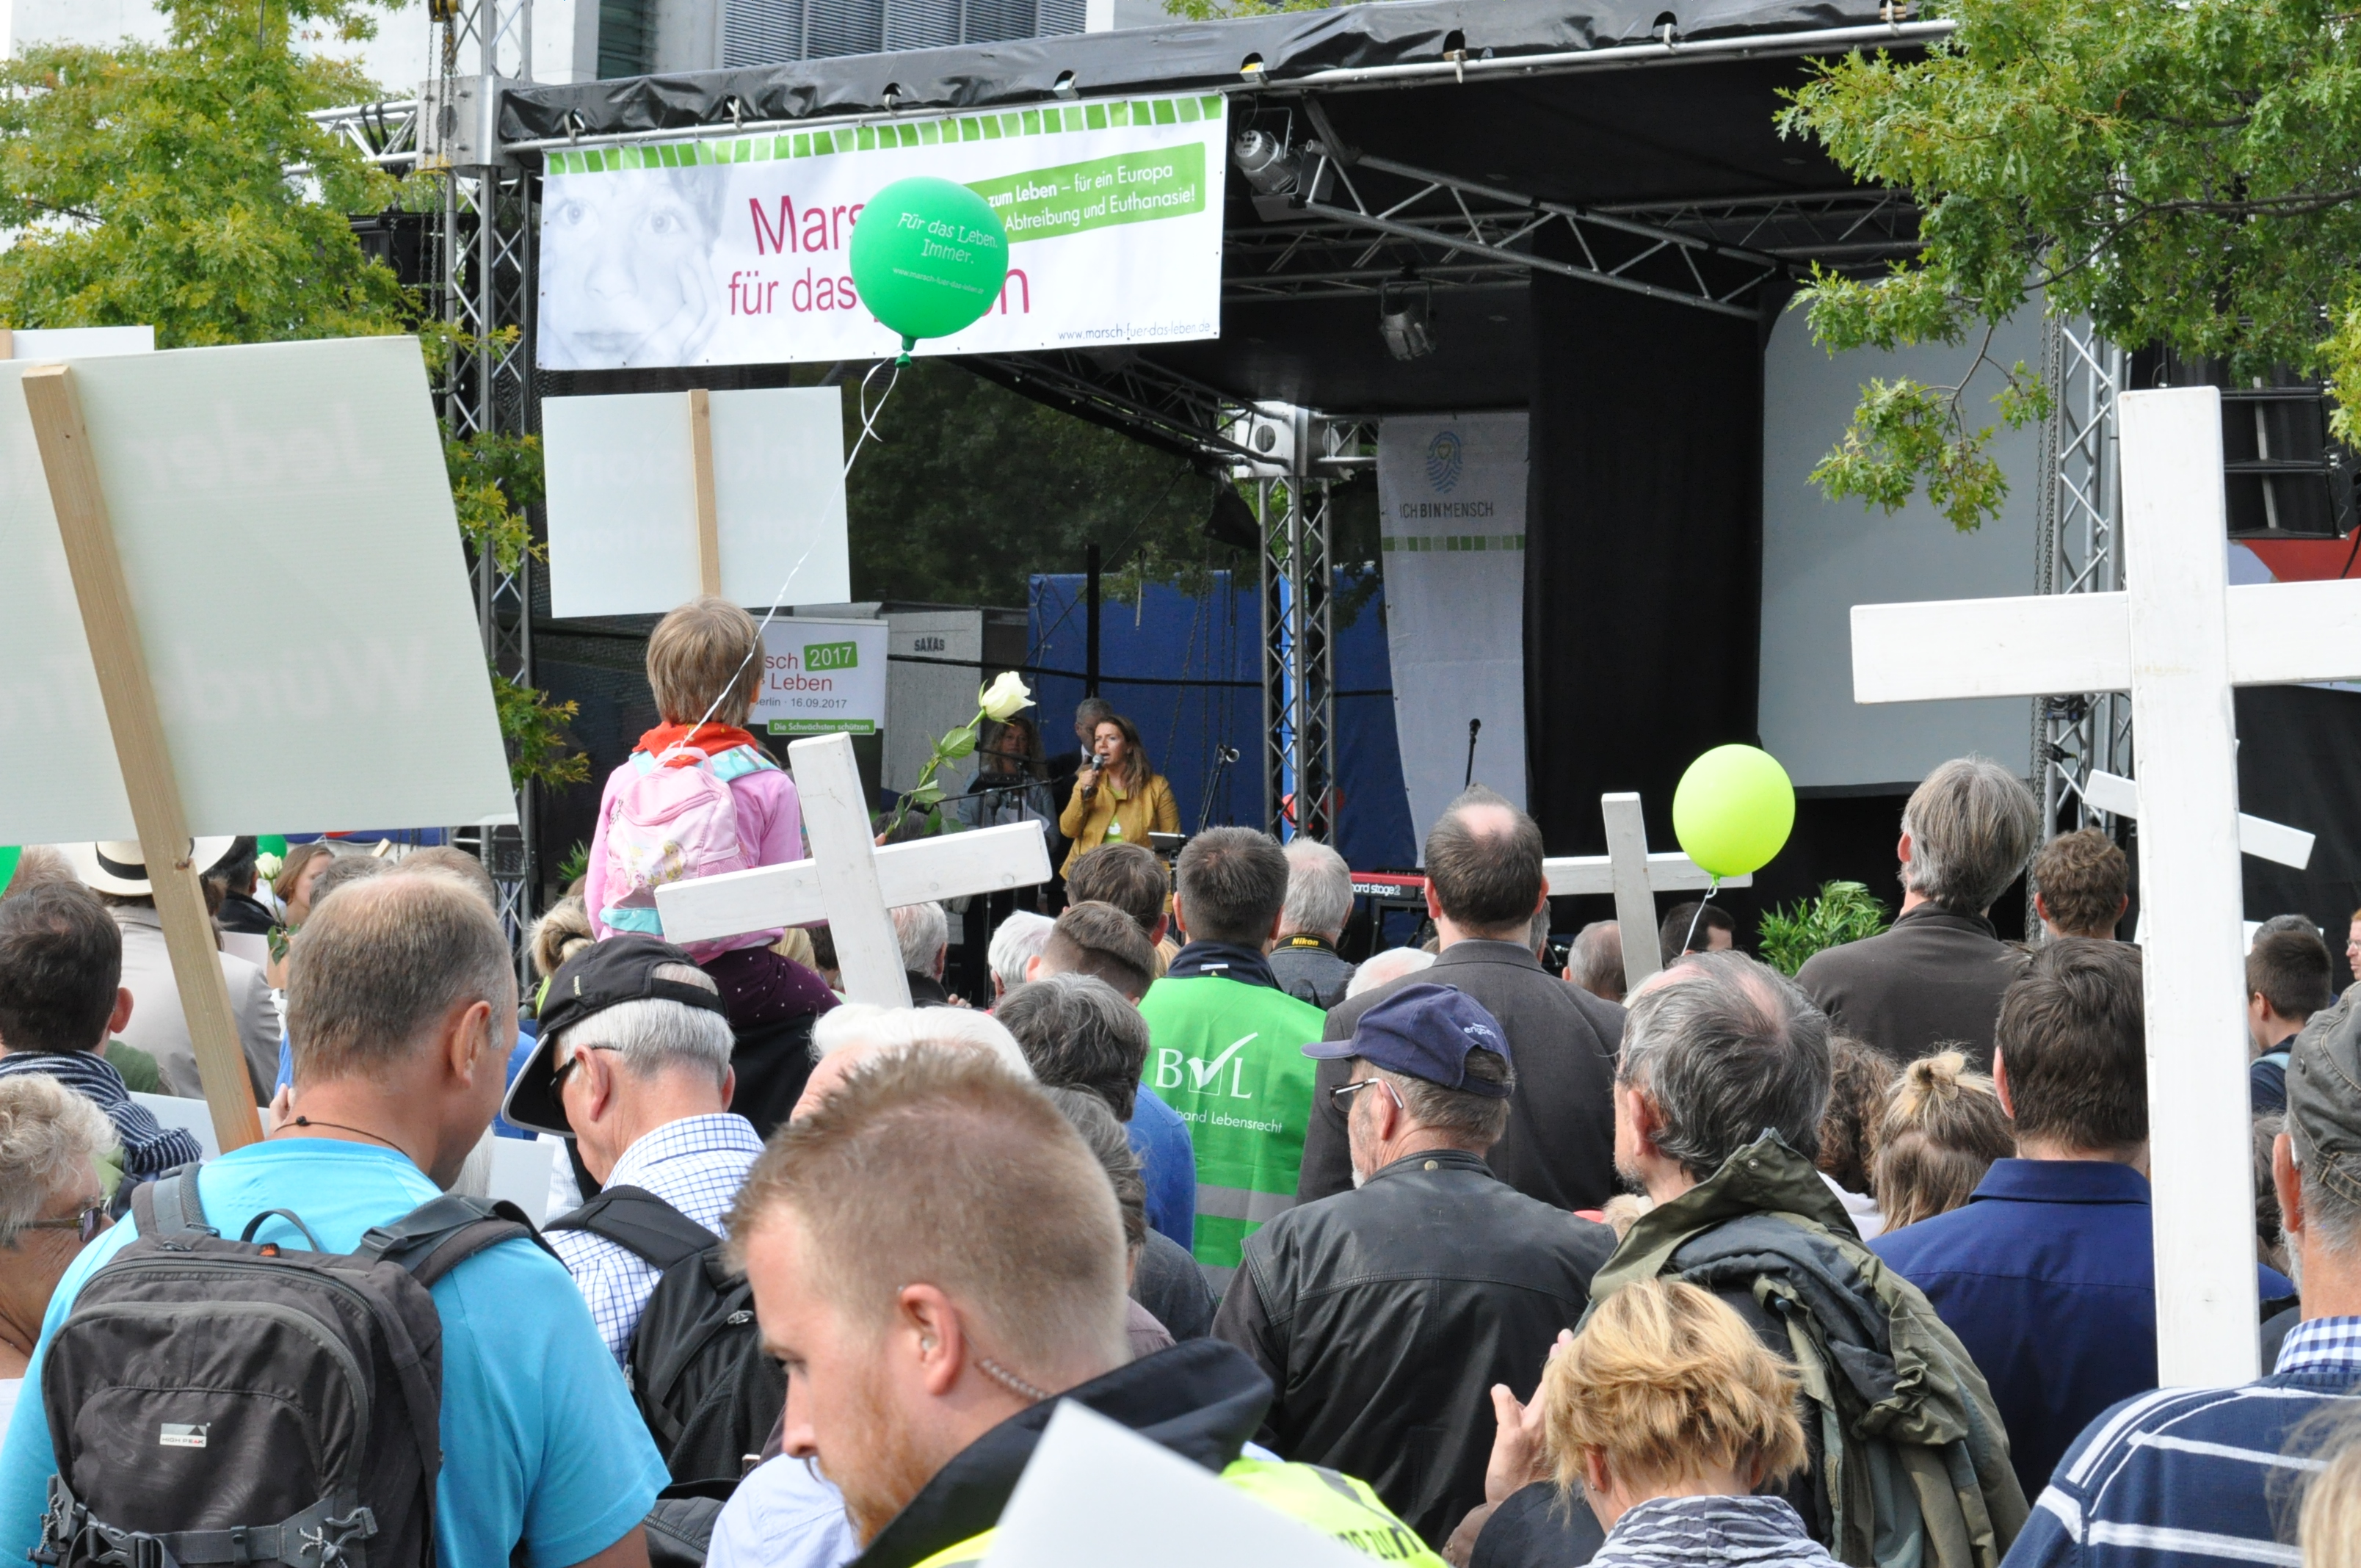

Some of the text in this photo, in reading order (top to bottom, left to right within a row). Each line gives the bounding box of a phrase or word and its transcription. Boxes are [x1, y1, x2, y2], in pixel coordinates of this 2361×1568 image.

[987, 164, 1173, 208] zum Leben für ein Europa
[1004, 184, 1195, 232] Abtreibung und Euthanasie!
[897, 212, 998, 248] Für das Leben.
[921, 239, 974, 264] Immer.
[728, 270, 779, 315] für
[792, 267, 857, 312] das
[1058, 318, 1210, 340] www.marsch-fuer-das-leben.de
[914, 637, 945, 652] SAXAS
[809, 646, 852, 667] 2017
[771, 672, 833, 692] Leben
[756, 697, 847, 709] erlin 16.09.2017
[774, 722, 869, 731] Die Schwächsten schützen
[1292, 937, 1319, 946] Nikon
[1211, 1111, 1283, 1133] Lebensrecht
